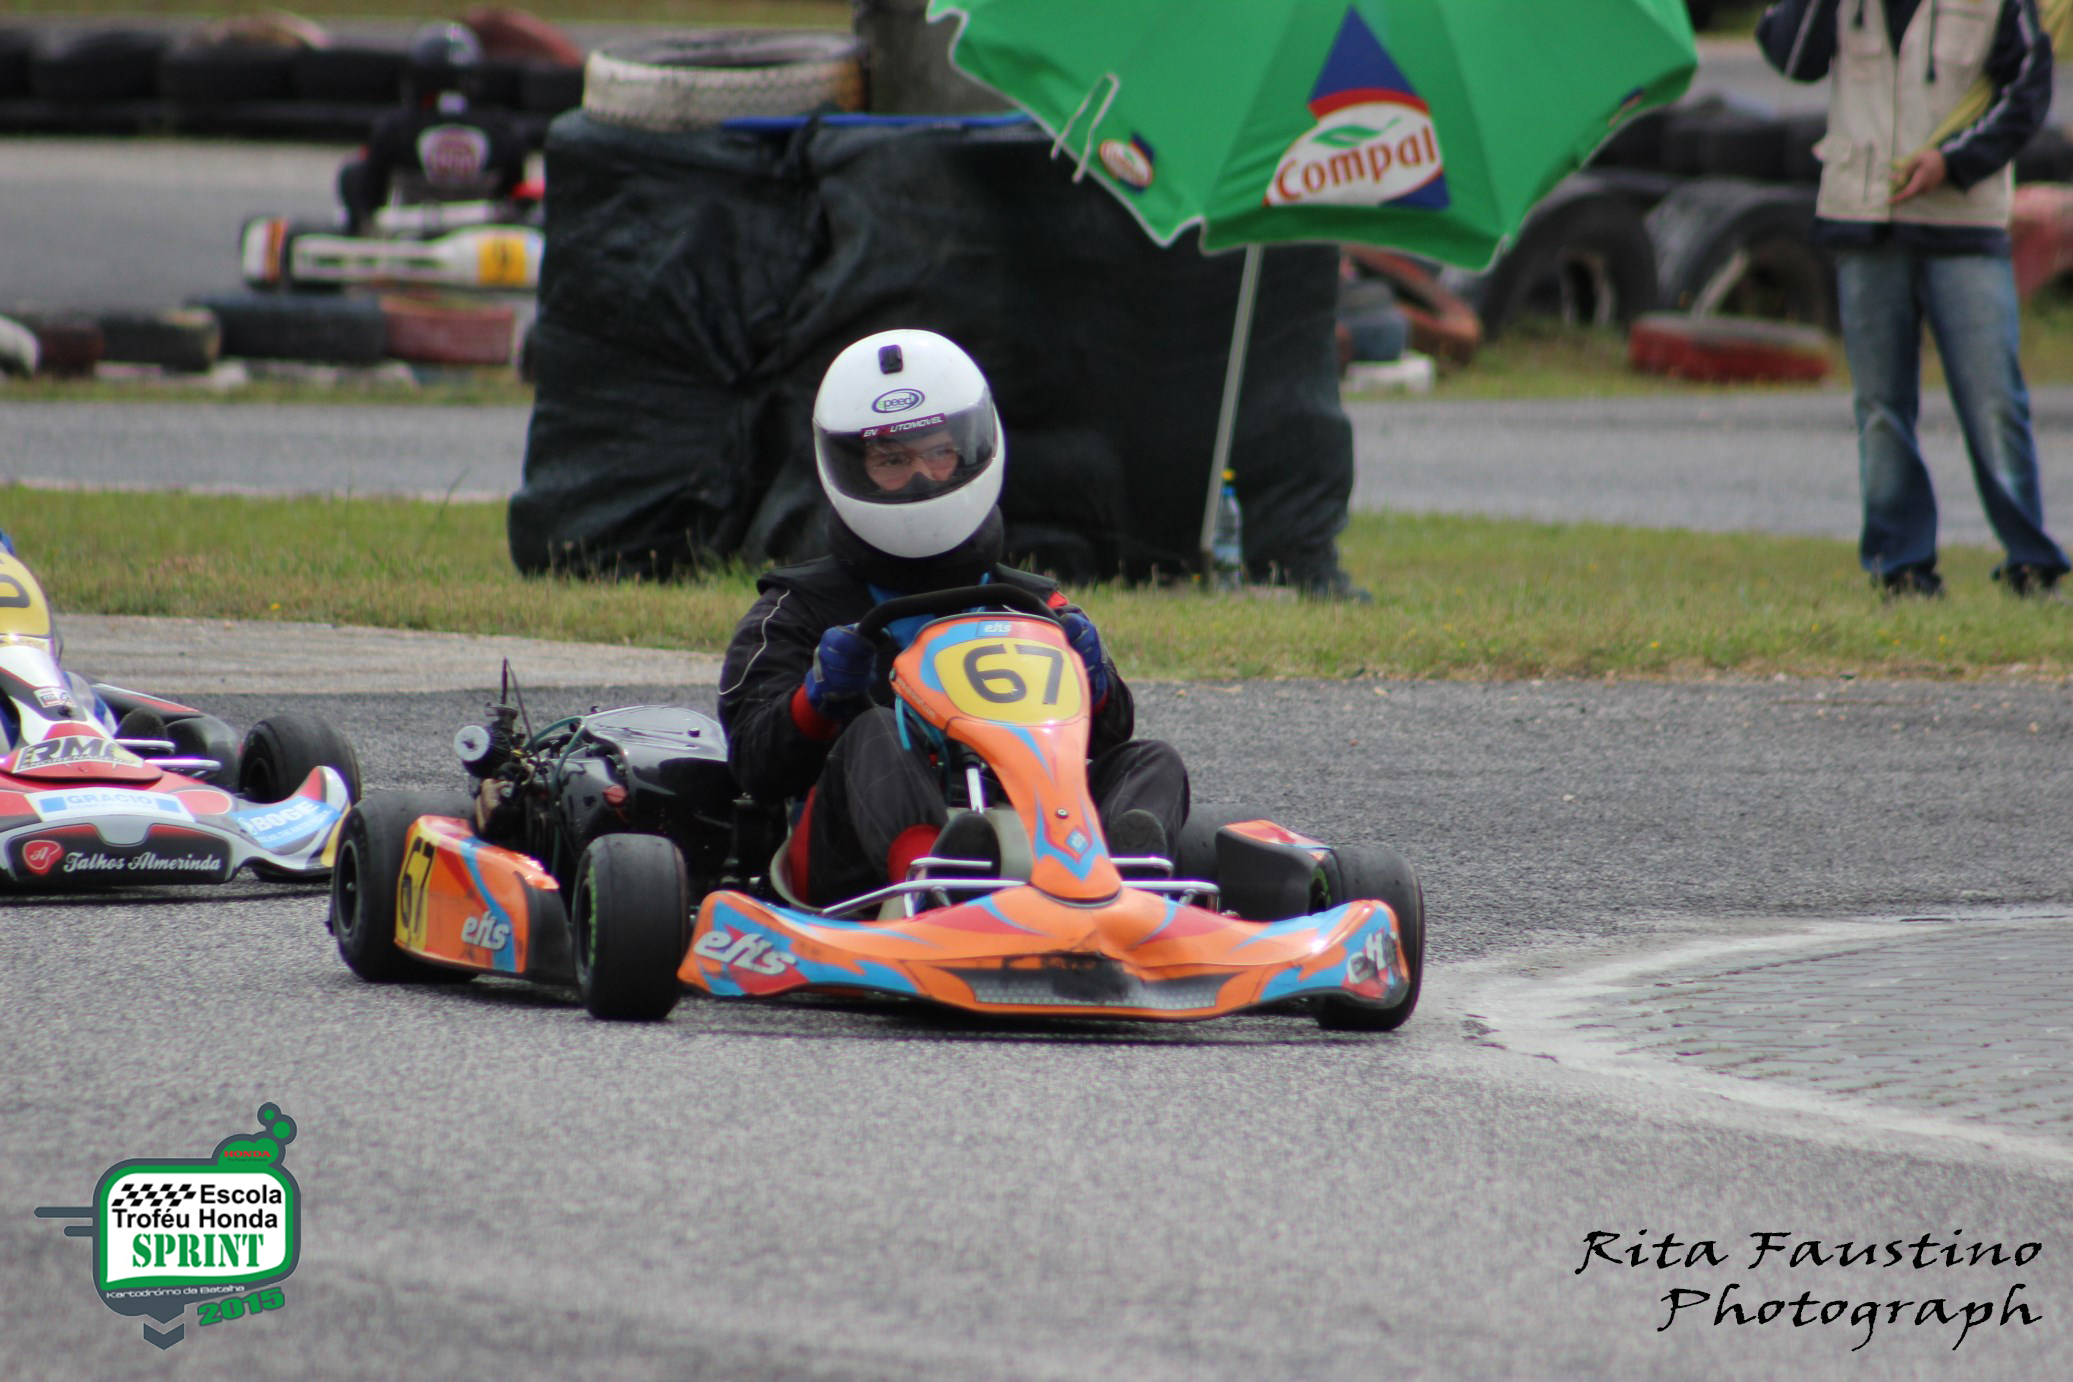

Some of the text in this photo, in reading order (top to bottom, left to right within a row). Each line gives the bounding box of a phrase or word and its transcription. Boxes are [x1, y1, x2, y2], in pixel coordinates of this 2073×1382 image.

[1276, 125, 1436, 203] Compal
[877, 393, 912, 412] peed
[963, 643, 1065, 705] 67
[249, 800, 320, 832] BOGE
[127, 852, 221, 871] Almerinda
